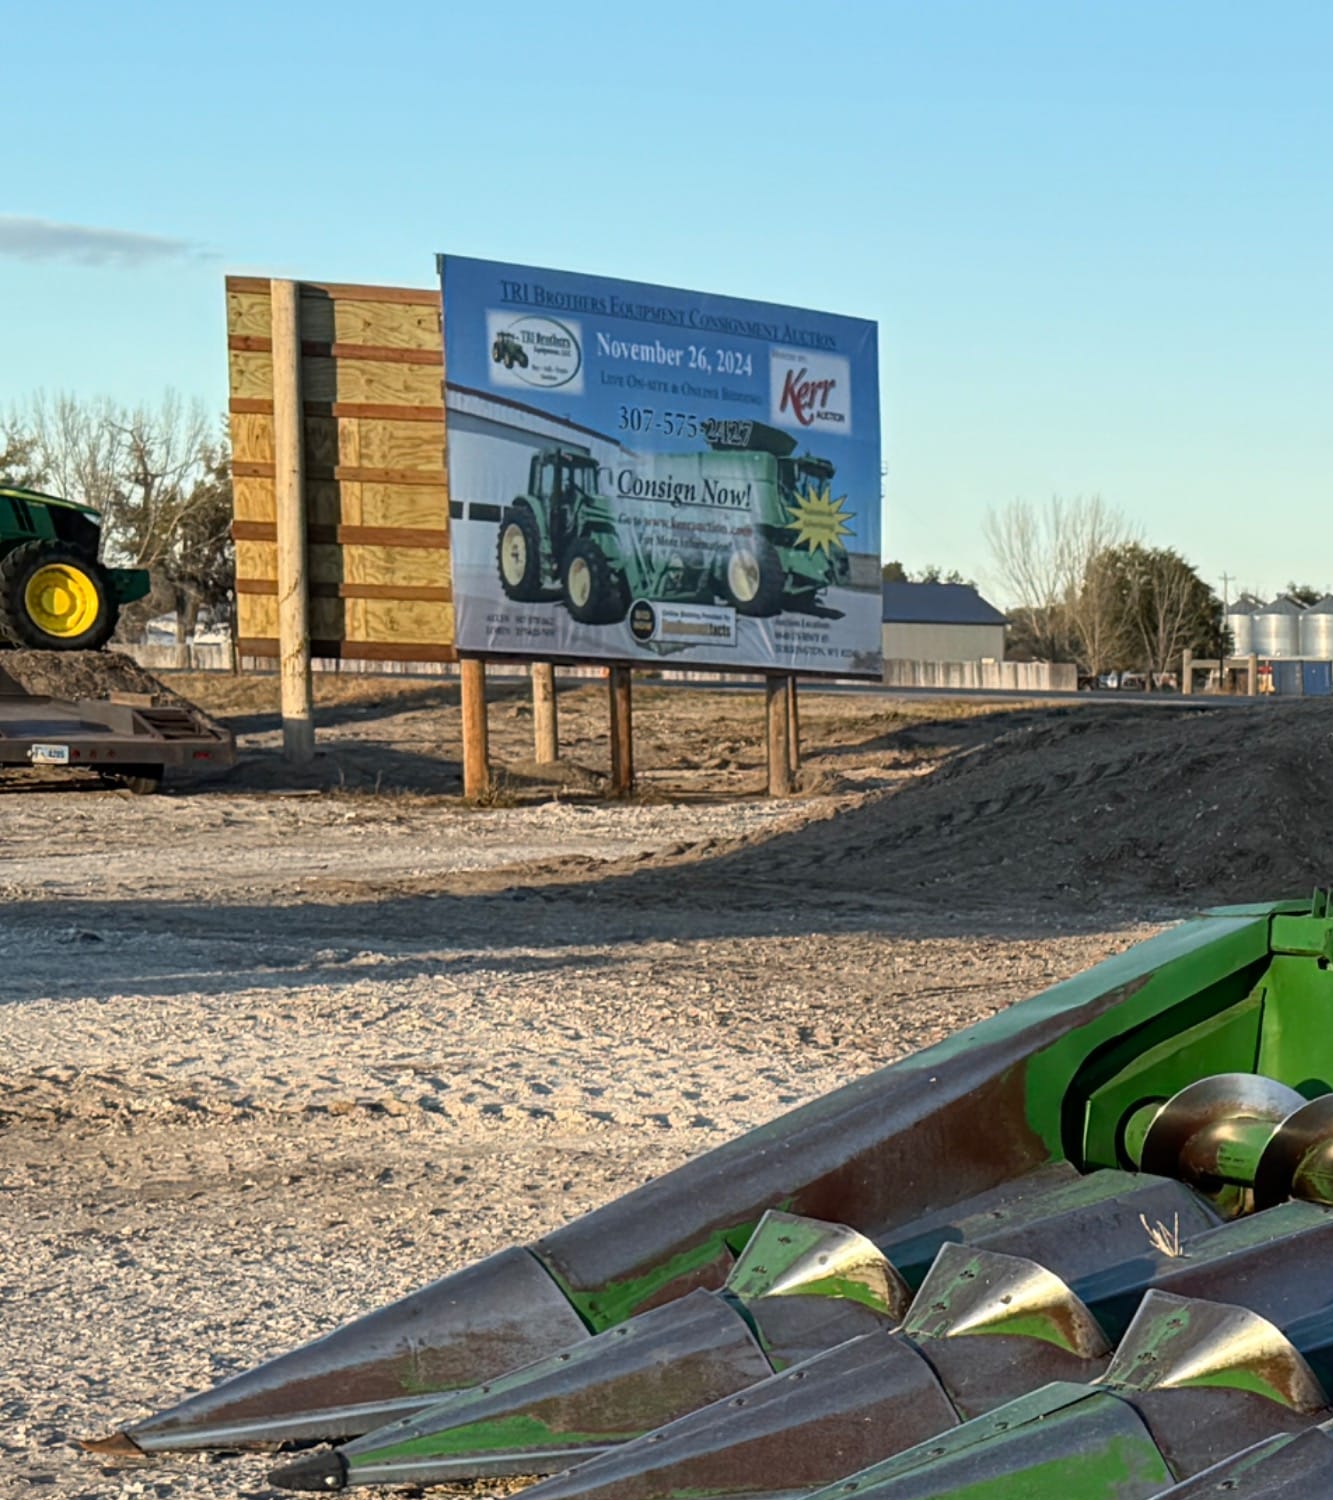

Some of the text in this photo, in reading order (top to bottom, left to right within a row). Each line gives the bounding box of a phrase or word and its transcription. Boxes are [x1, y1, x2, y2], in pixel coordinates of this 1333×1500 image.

[596, 332, 684, 367] November
[687, 345, 712, 375] 26,
[716, 349, 753, 376] 2024
[780, 368, 836, 427] Kerr
[816, 410, 846, 424] AUCTION
[618, 405, 753, 447] 307-575-2427
[617, 469, 752, 508] Consign Now!
